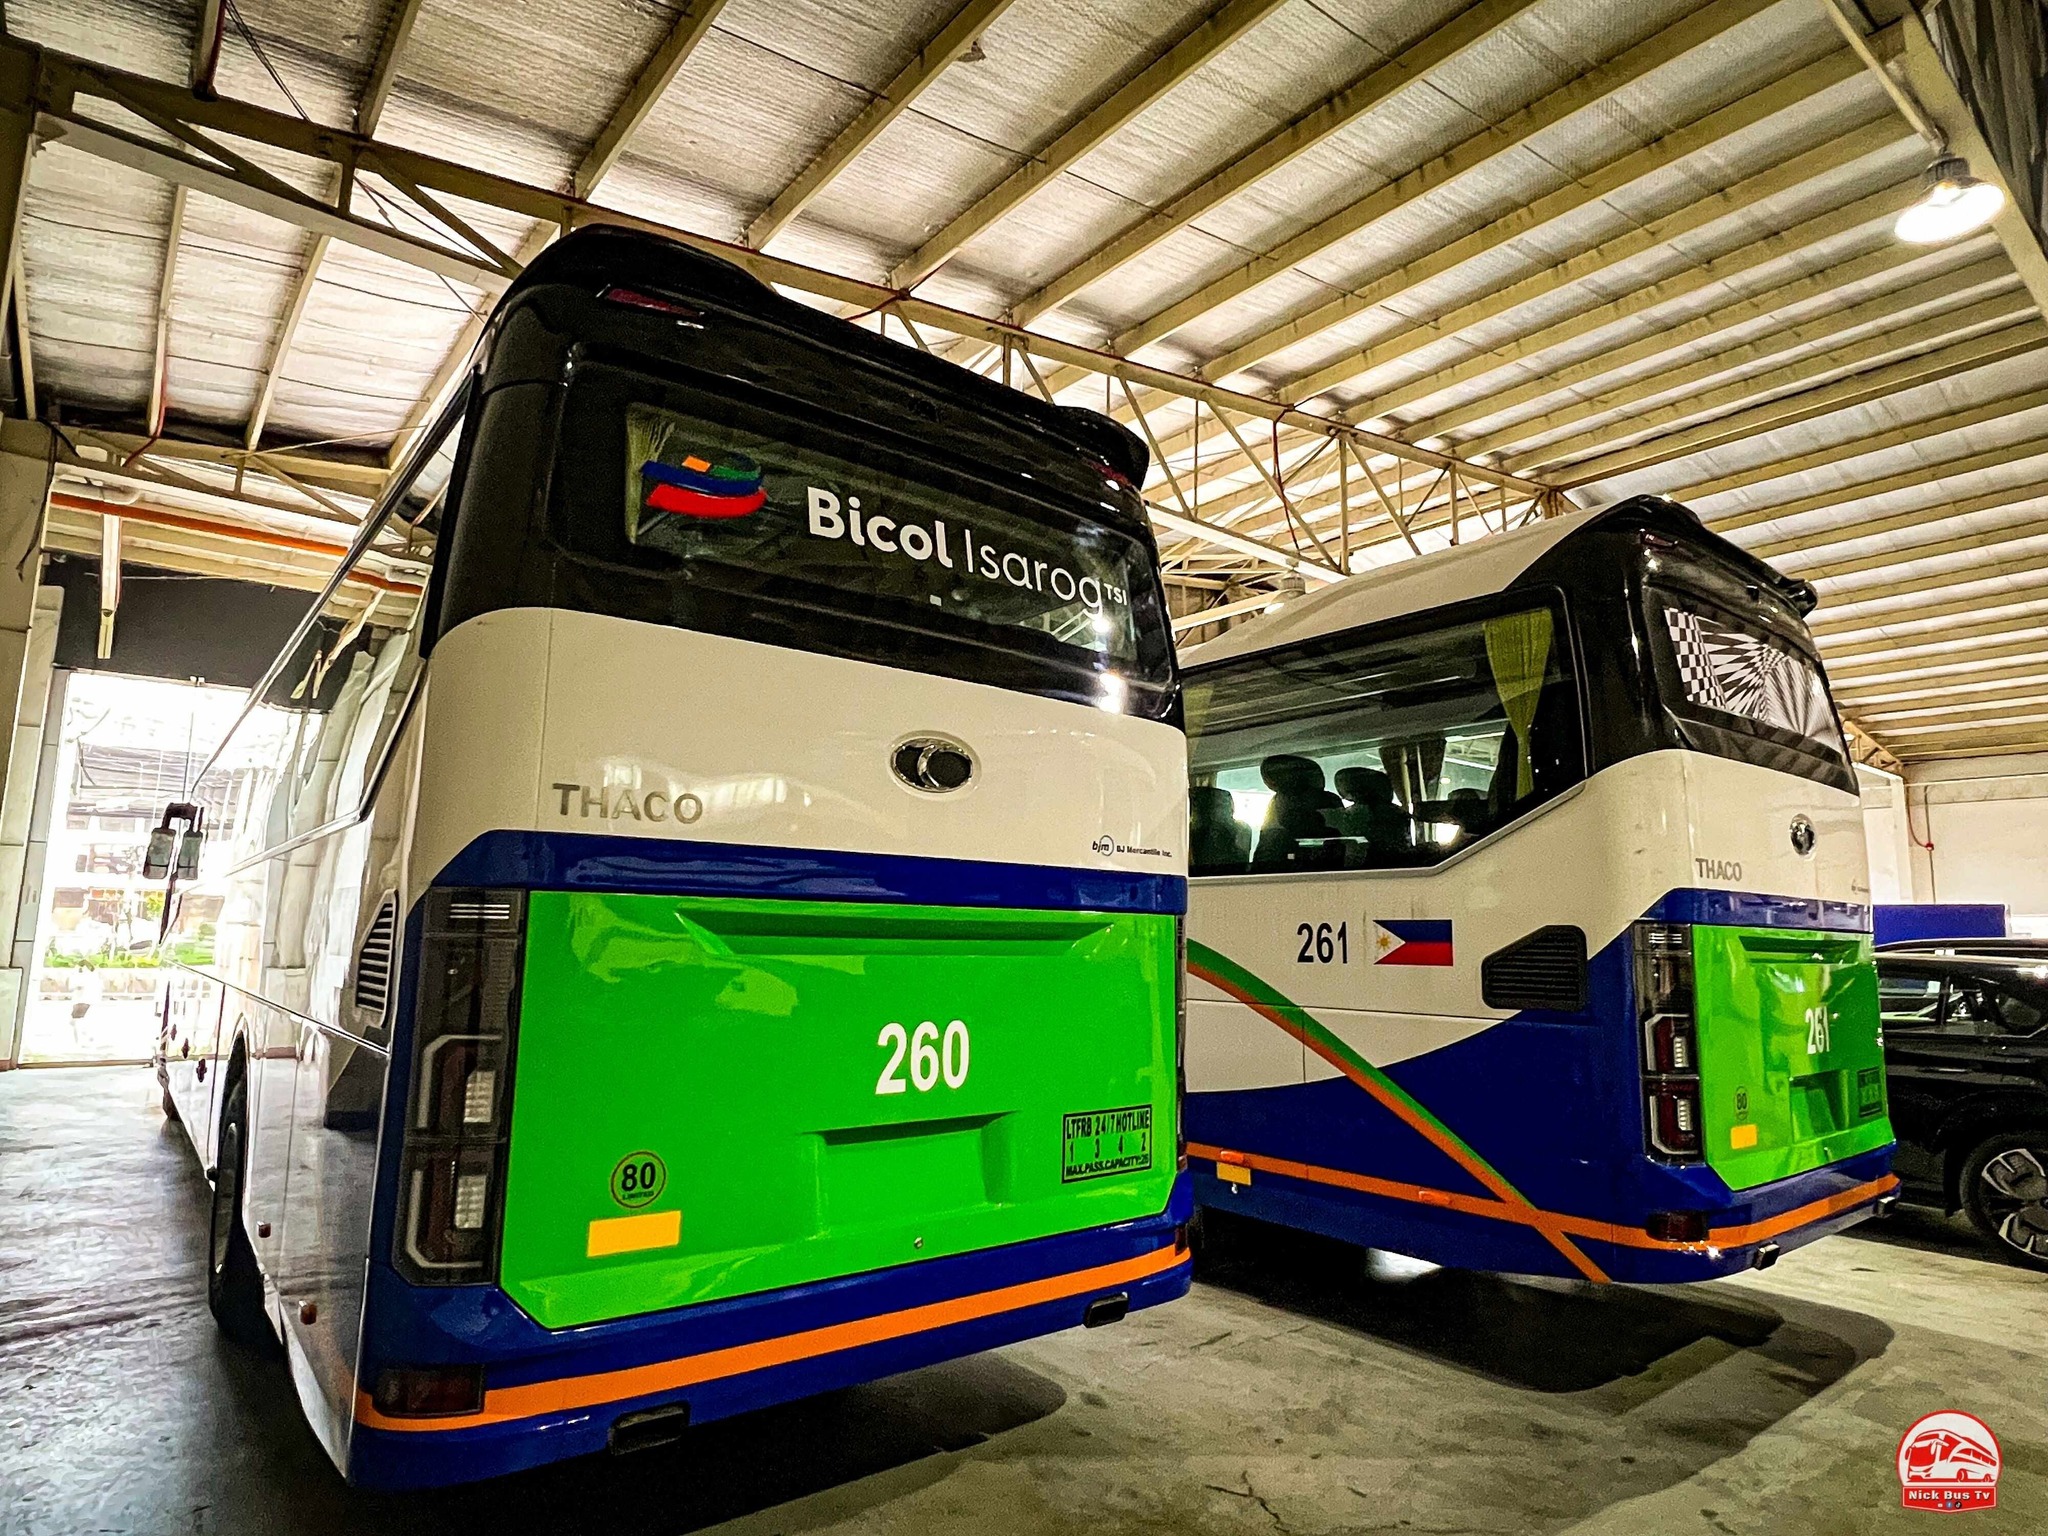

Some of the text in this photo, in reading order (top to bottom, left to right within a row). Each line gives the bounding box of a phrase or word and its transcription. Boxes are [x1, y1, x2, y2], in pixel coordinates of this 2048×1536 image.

[808, 486, 1128, 620] Bicol Isarog TSI
[552, 783, 703, 825] THACO
[1127, 846, 1160, 856] Mercantile
[1162, 850, 1173, 858] Inc.
[1695, 857, 1742, 882] THACO
[1297, 921, 1348, 964] 261
[1805, 1005, 1830, 1055] 261
[875, 1019, 970, 1095] 260
[1066, 1116, 1092, 1140] LTFRB
[1116, 1109, 1149, 1134] HOTLINE
[621, 1161, 656, 1192] 80
